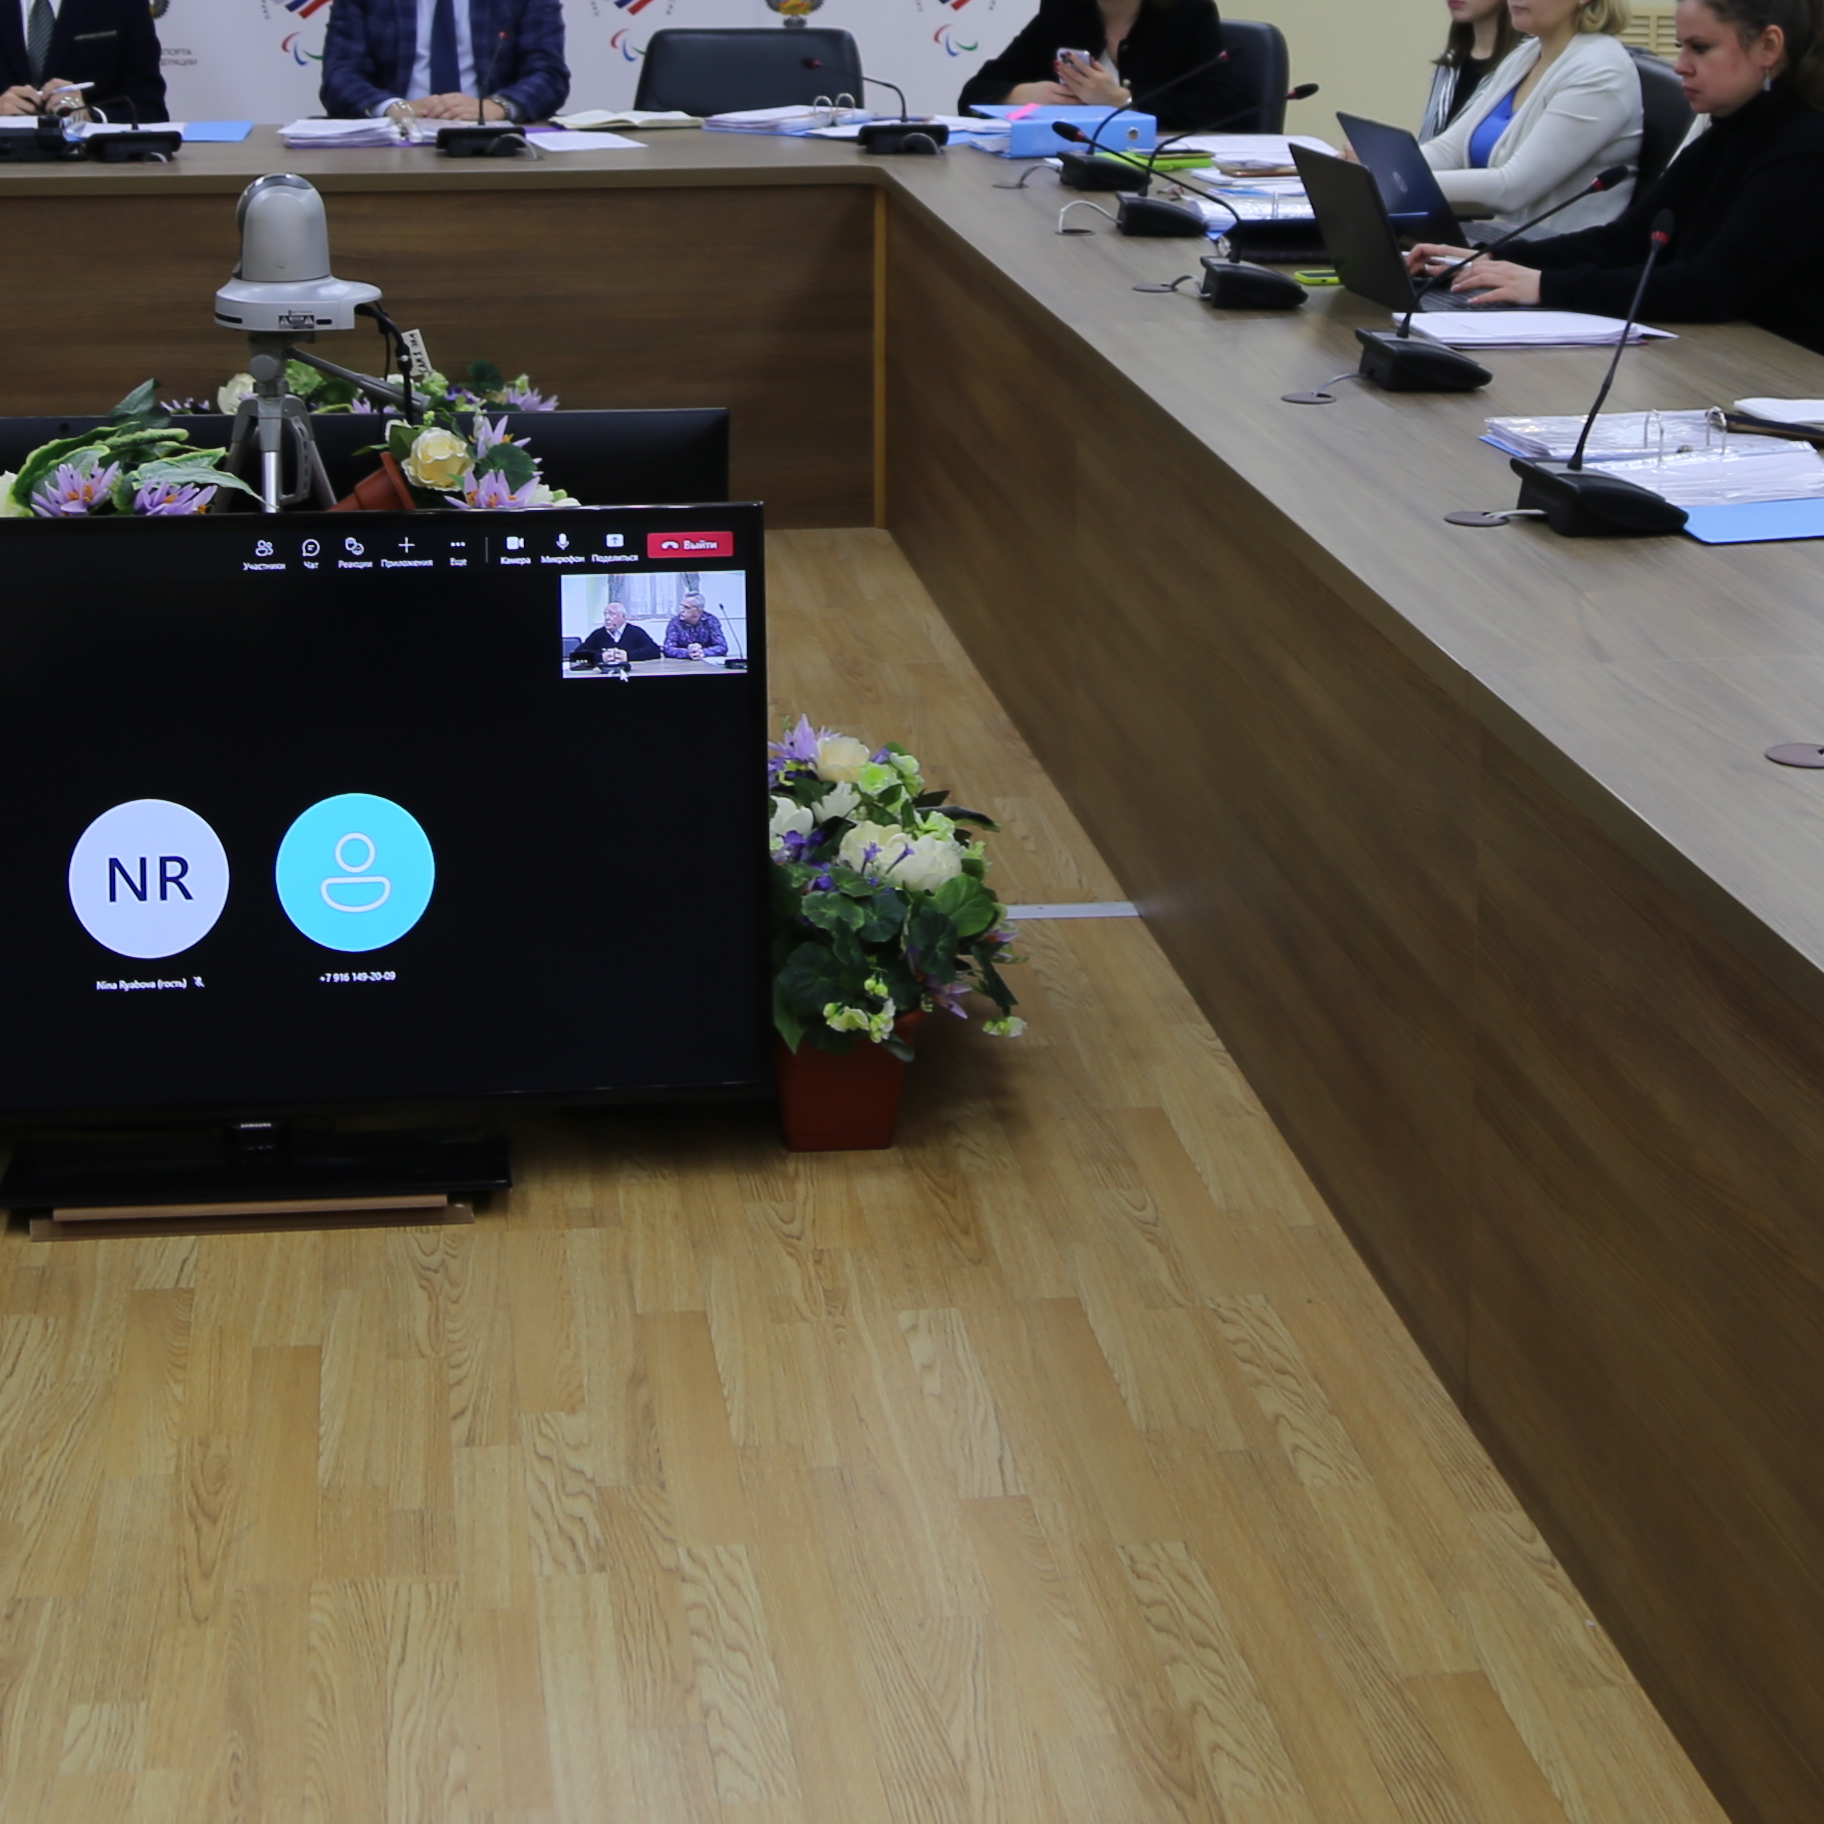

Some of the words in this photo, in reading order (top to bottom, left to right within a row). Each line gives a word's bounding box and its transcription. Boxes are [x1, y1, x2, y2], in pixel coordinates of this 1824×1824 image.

[683, 539, 718, 550] Выйти
[500, 556, 531, 565] Камера
[541, 555, 585, 565] Микрофон
[591, 554, 638, 563] Поделиться
[303, 560, 319, 569] Чат
[338, 560, 373, 569] Реакции
[381, 559, 433, 568] Приложения
[108, 855, 194, 902] NR
[96, 980, 117, 990] Nina
